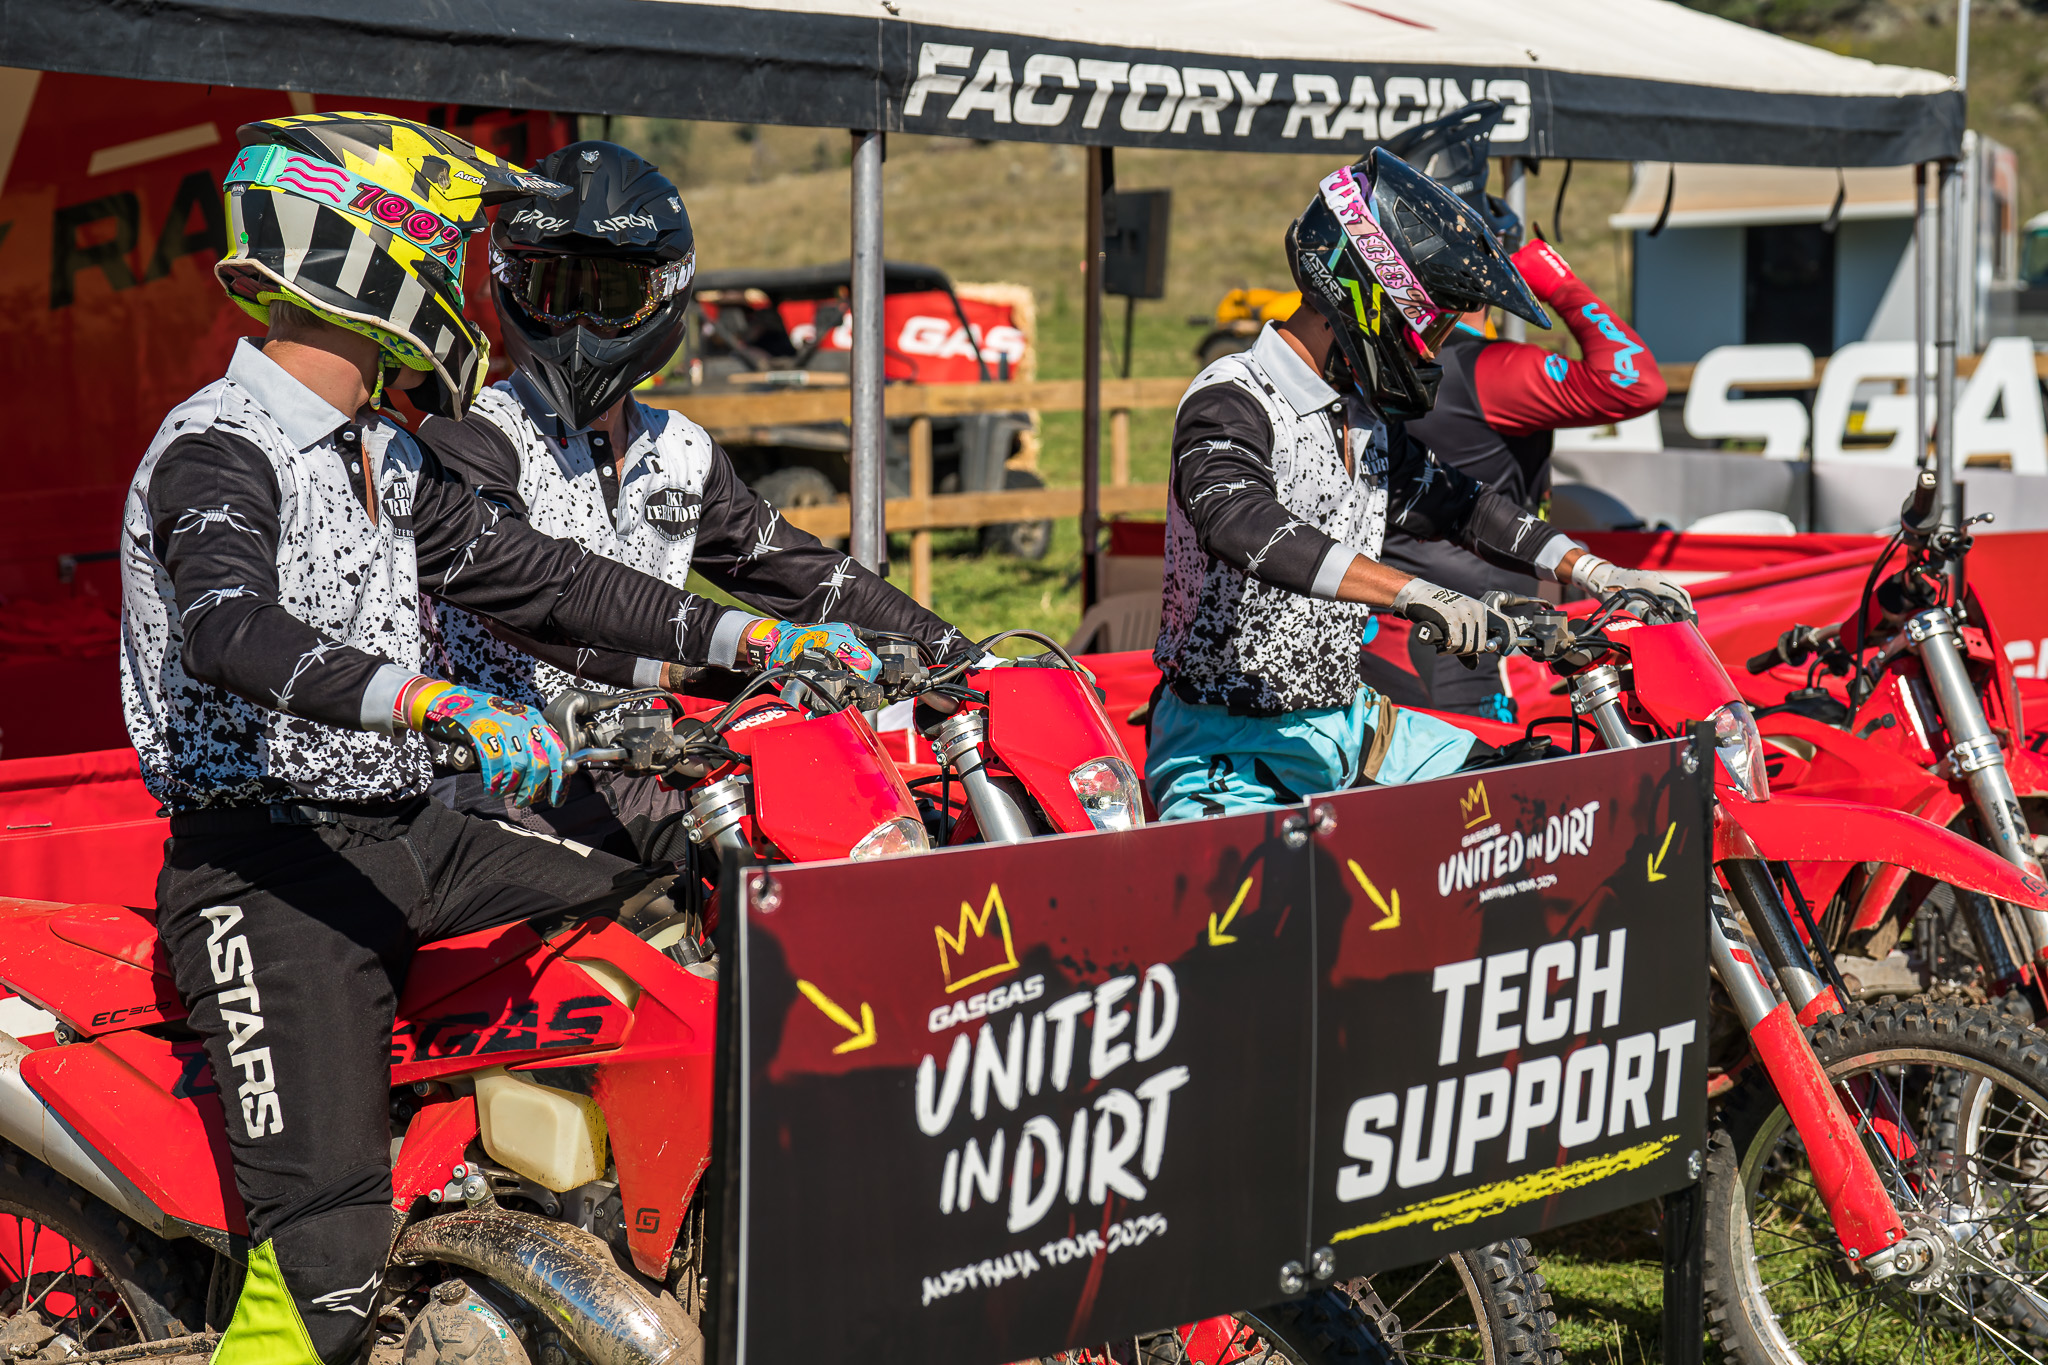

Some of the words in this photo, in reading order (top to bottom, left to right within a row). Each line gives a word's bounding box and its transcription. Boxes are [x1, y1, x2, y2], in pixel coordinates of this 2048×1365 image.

[903, 42, 1278, 137] FACTORY
[1281, 73, 1532, 142] RACING
[1300, 254, 1314, 275] BUILT
[1311, 271, 1324, 289] FOR
[590, 377, 609, 407] AIROH
[729, 707, 788, 732] GASGAS
[1437, 830, 1525, 897] UNITED
[1526, 832, 1544, 860] IN
[1544, 800, 1601, 864] DIRT
[200, 904, 285, 1139] ASTARS
[927, 974, 1044, 1033] GASGAS
[1431, 927, 1627, 1067] TECH
[915, 962, 1180, 1136] UNITED
[939, 1128, 1005, 1214] IN
[1006, 1065, 1190, 1234] DIRT
[1336, 1019, 1696, 1202] SUPPORT
[922, 1250, 1040, 1307] AUSTRALIA
[1039, 1229, 1106, 1267] TOUR
[1106, 1212, 1168, 1254] 2025
